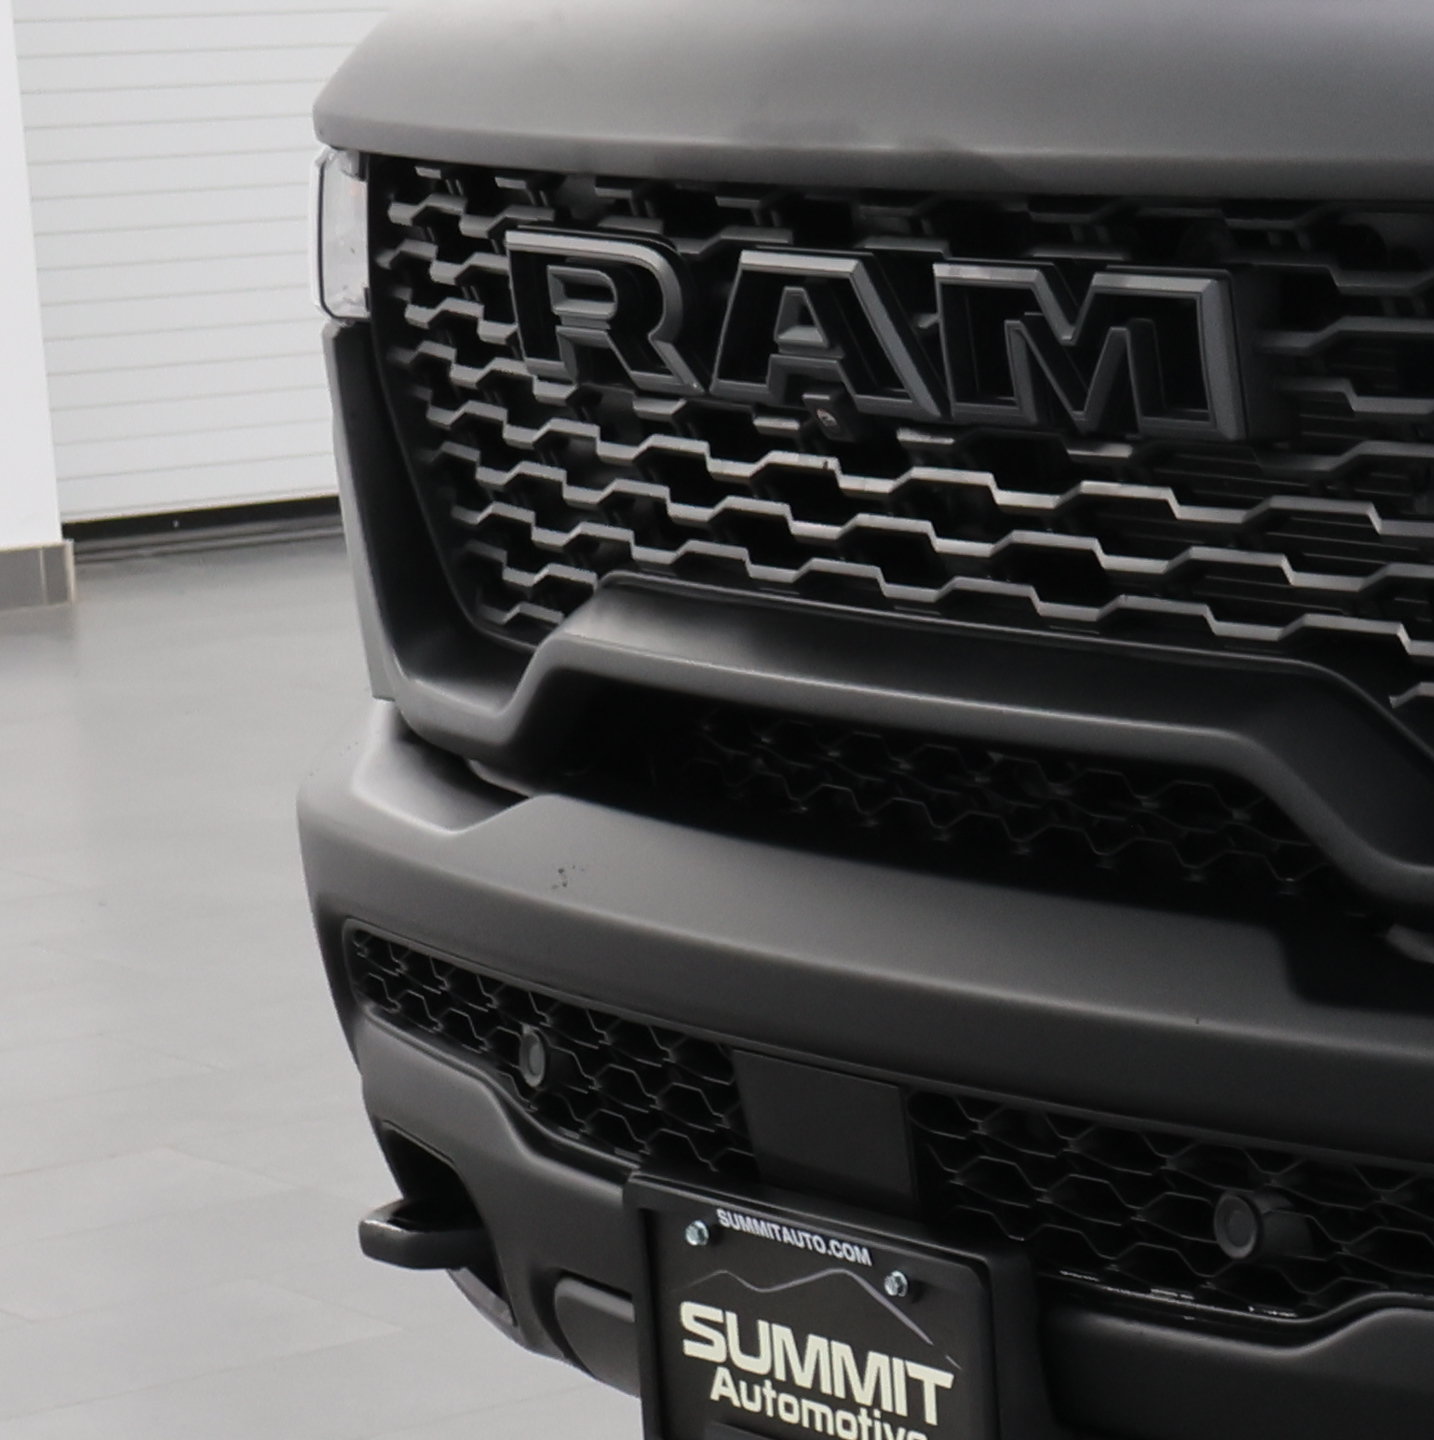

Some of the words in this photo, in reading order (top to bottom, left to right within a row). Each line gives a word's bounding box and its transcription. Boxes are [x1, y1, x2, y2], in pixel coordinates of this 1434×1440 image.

[505, 226, 1248, 440] RAM
[716, 1208, 872, 1266] SUMMITAUTO.COM
[680, 1301, 954, 1426] SUMMIT
